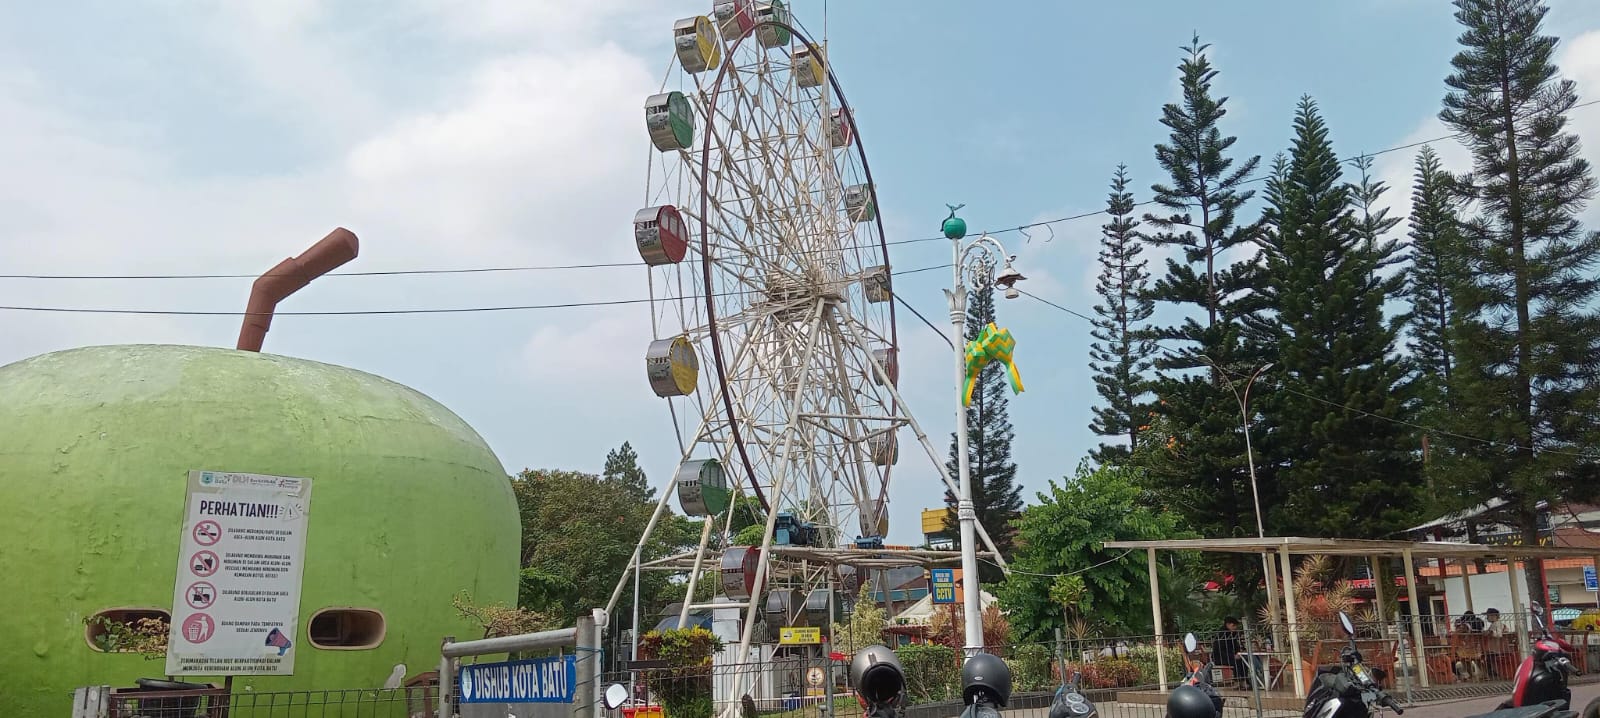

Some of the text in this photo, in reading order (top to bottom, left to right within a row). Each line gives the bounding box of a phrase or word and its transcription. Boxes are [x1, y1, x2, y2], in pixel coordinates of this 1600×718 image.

[200, 500, 278, 518] PERHATIAN!!!
[936, 587, 952, 600] CCTV
[474, 660, 567, 699] DISHUB KOTA BATU
